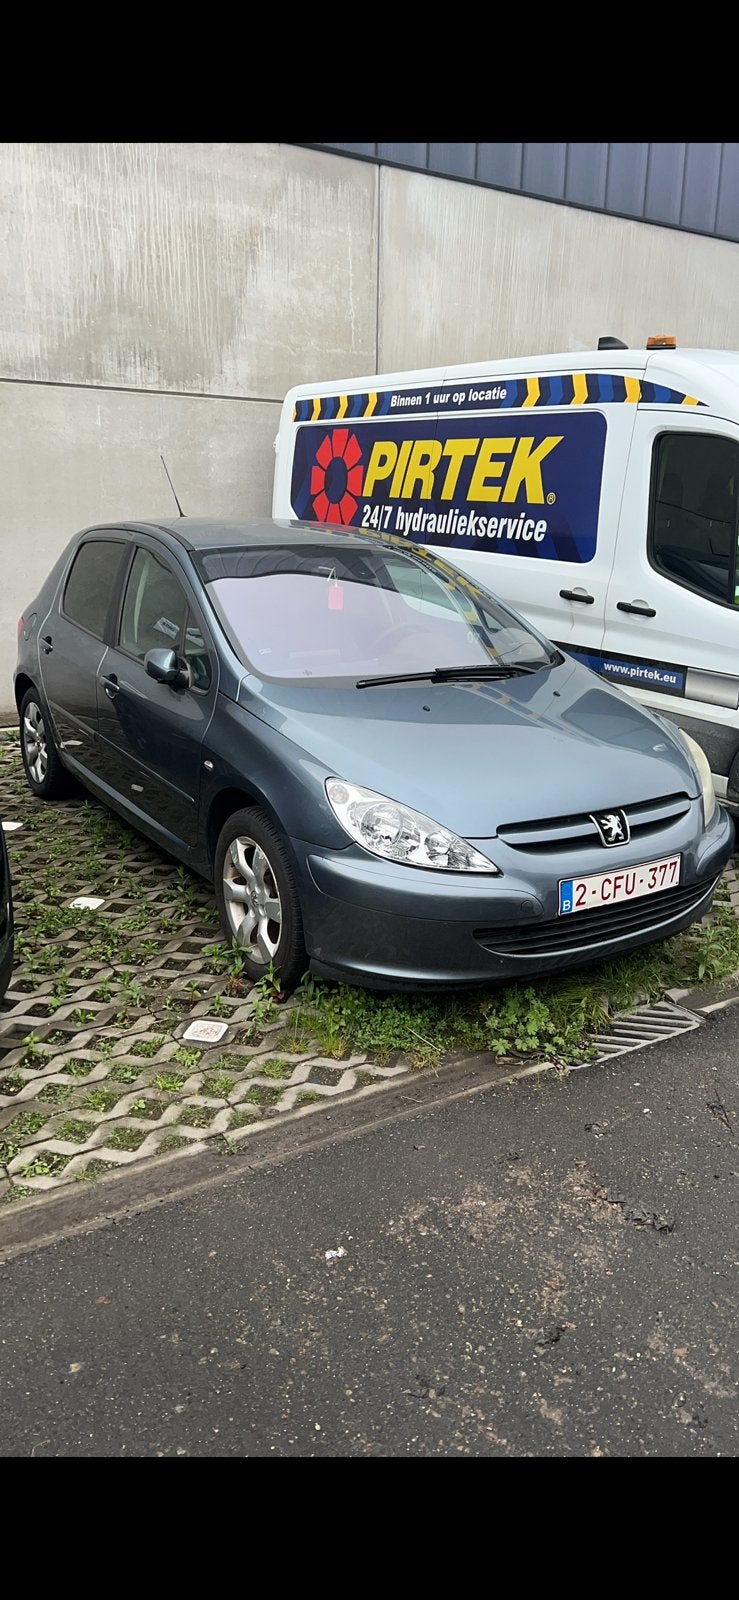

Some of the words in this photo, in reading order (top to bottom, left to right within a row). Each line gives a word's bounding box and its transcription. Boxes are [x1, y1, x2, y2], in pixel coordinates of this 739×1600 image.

[391, 395, 422, 407] Binnen
[425, 392, 431, 404] 1
[433, 393, 450, 404] uur
[453, 392, 466, 405] op
[468, 387, 507, 401] locatie
[362, 436, 564, 504] PIRTEK
[395, 506, 547, 542] hydrauliekservice
[603, 662, 677, 684] www.pirtek.eu
[575, 861, 678, 907] 2-CFU-377
[562, 900, 571, 911] B
